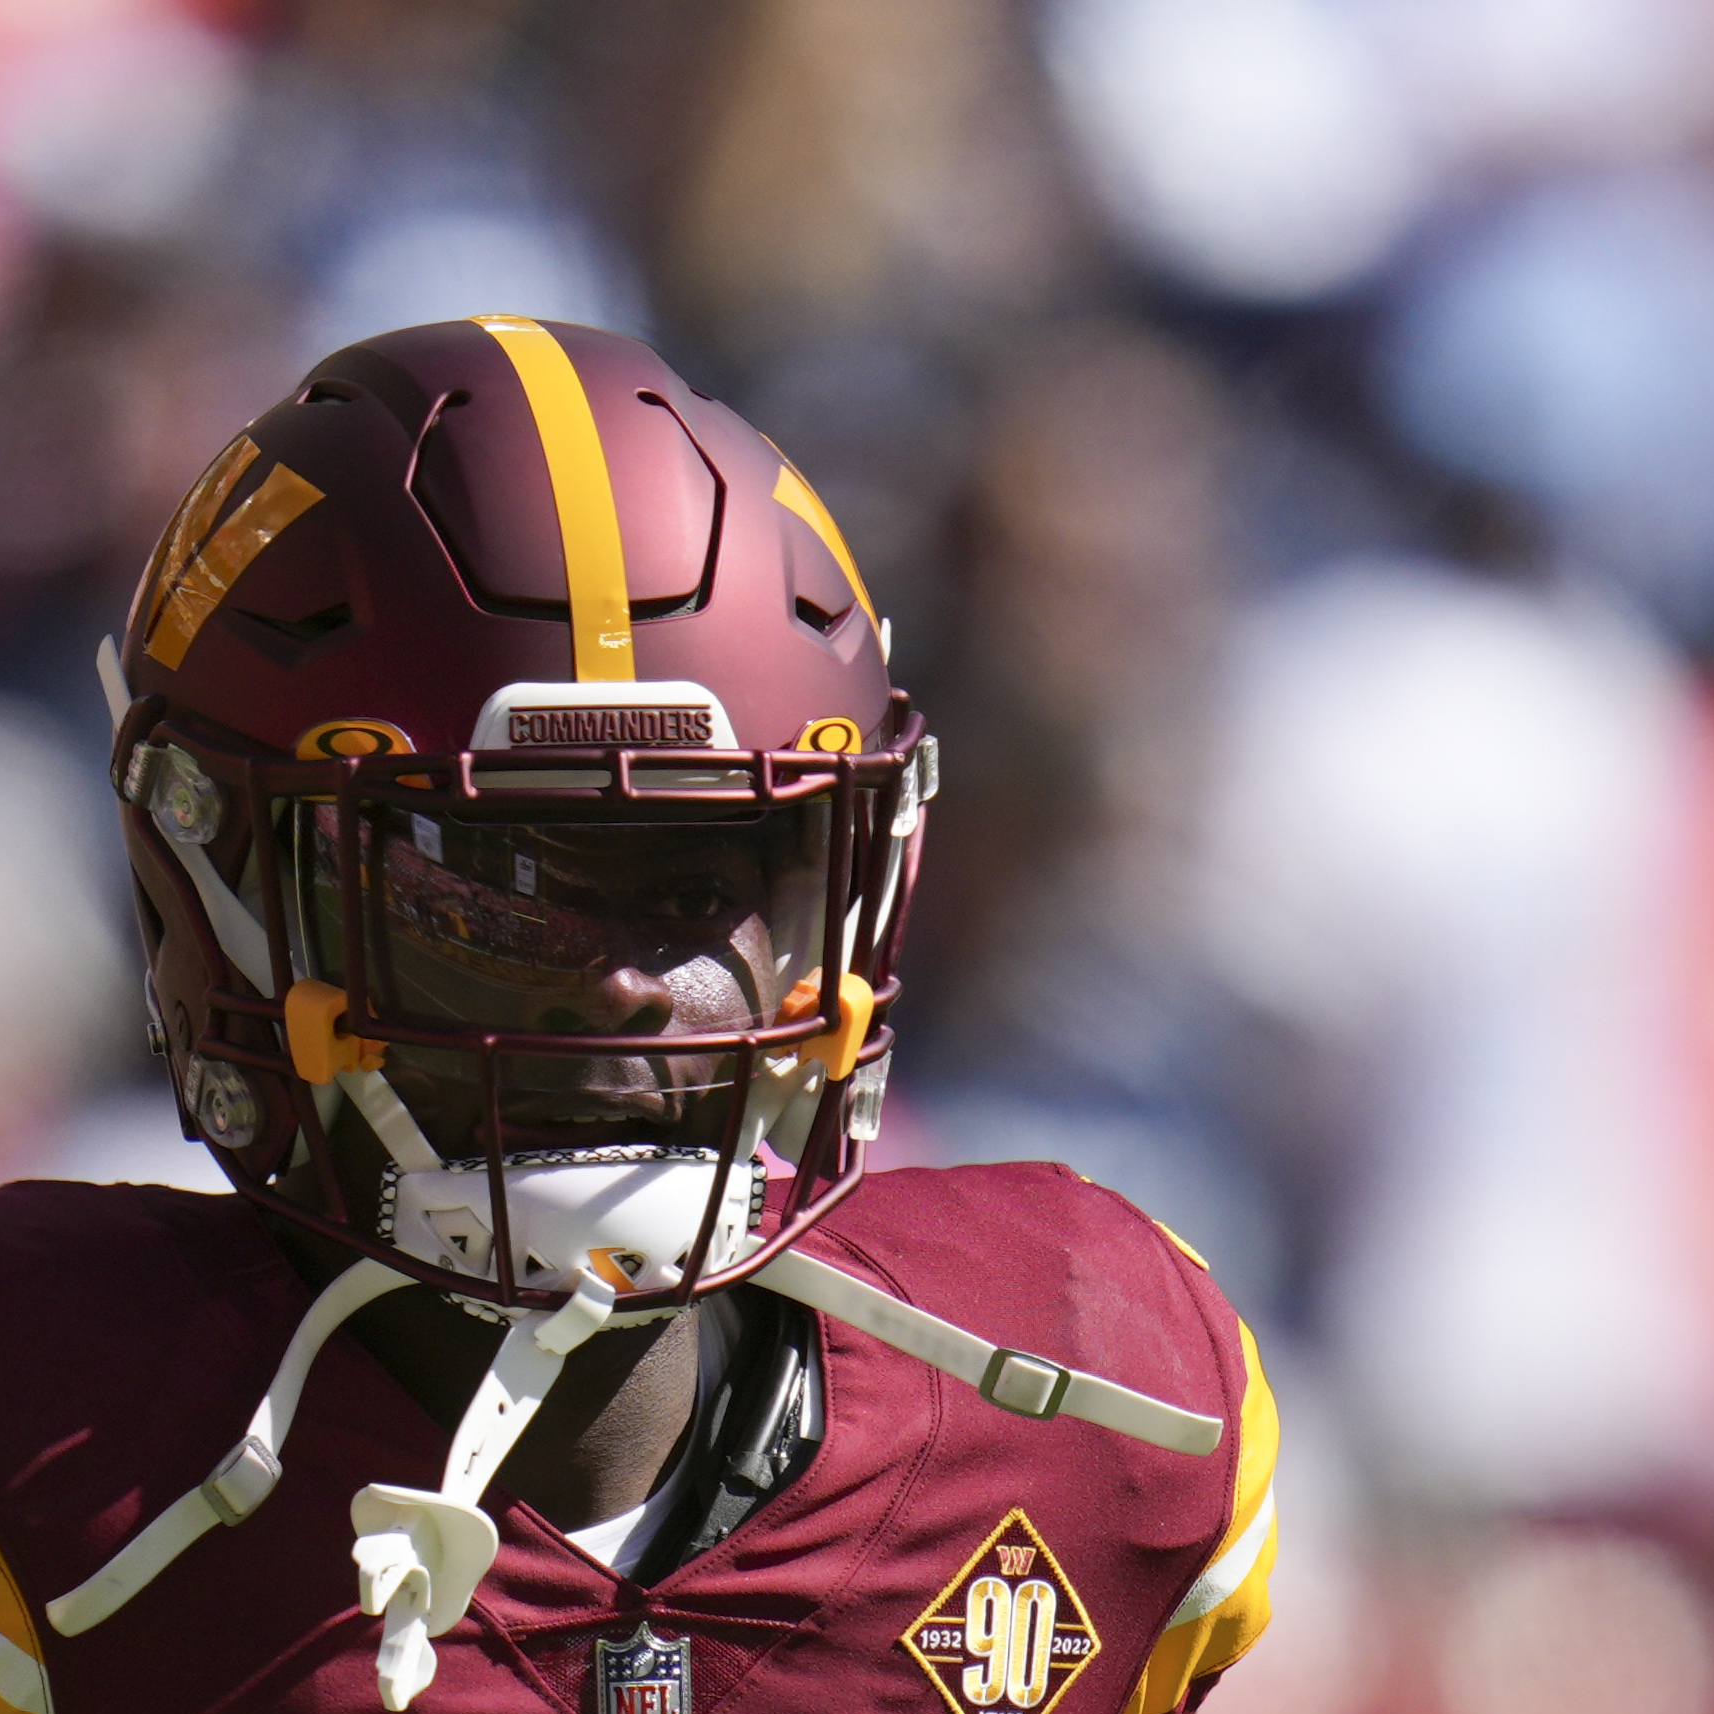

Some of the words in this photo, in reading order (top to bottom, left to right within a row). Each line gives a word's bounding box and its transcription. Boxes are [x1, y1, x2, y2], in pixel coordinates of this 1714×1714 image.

[509, 710, 713, 743] COMMANDERS
[920, 1629, 962, 1649] 1932
[962, 1576, 1057, 1709] 90
[1051, 1637, 1091, 1655] 2022
